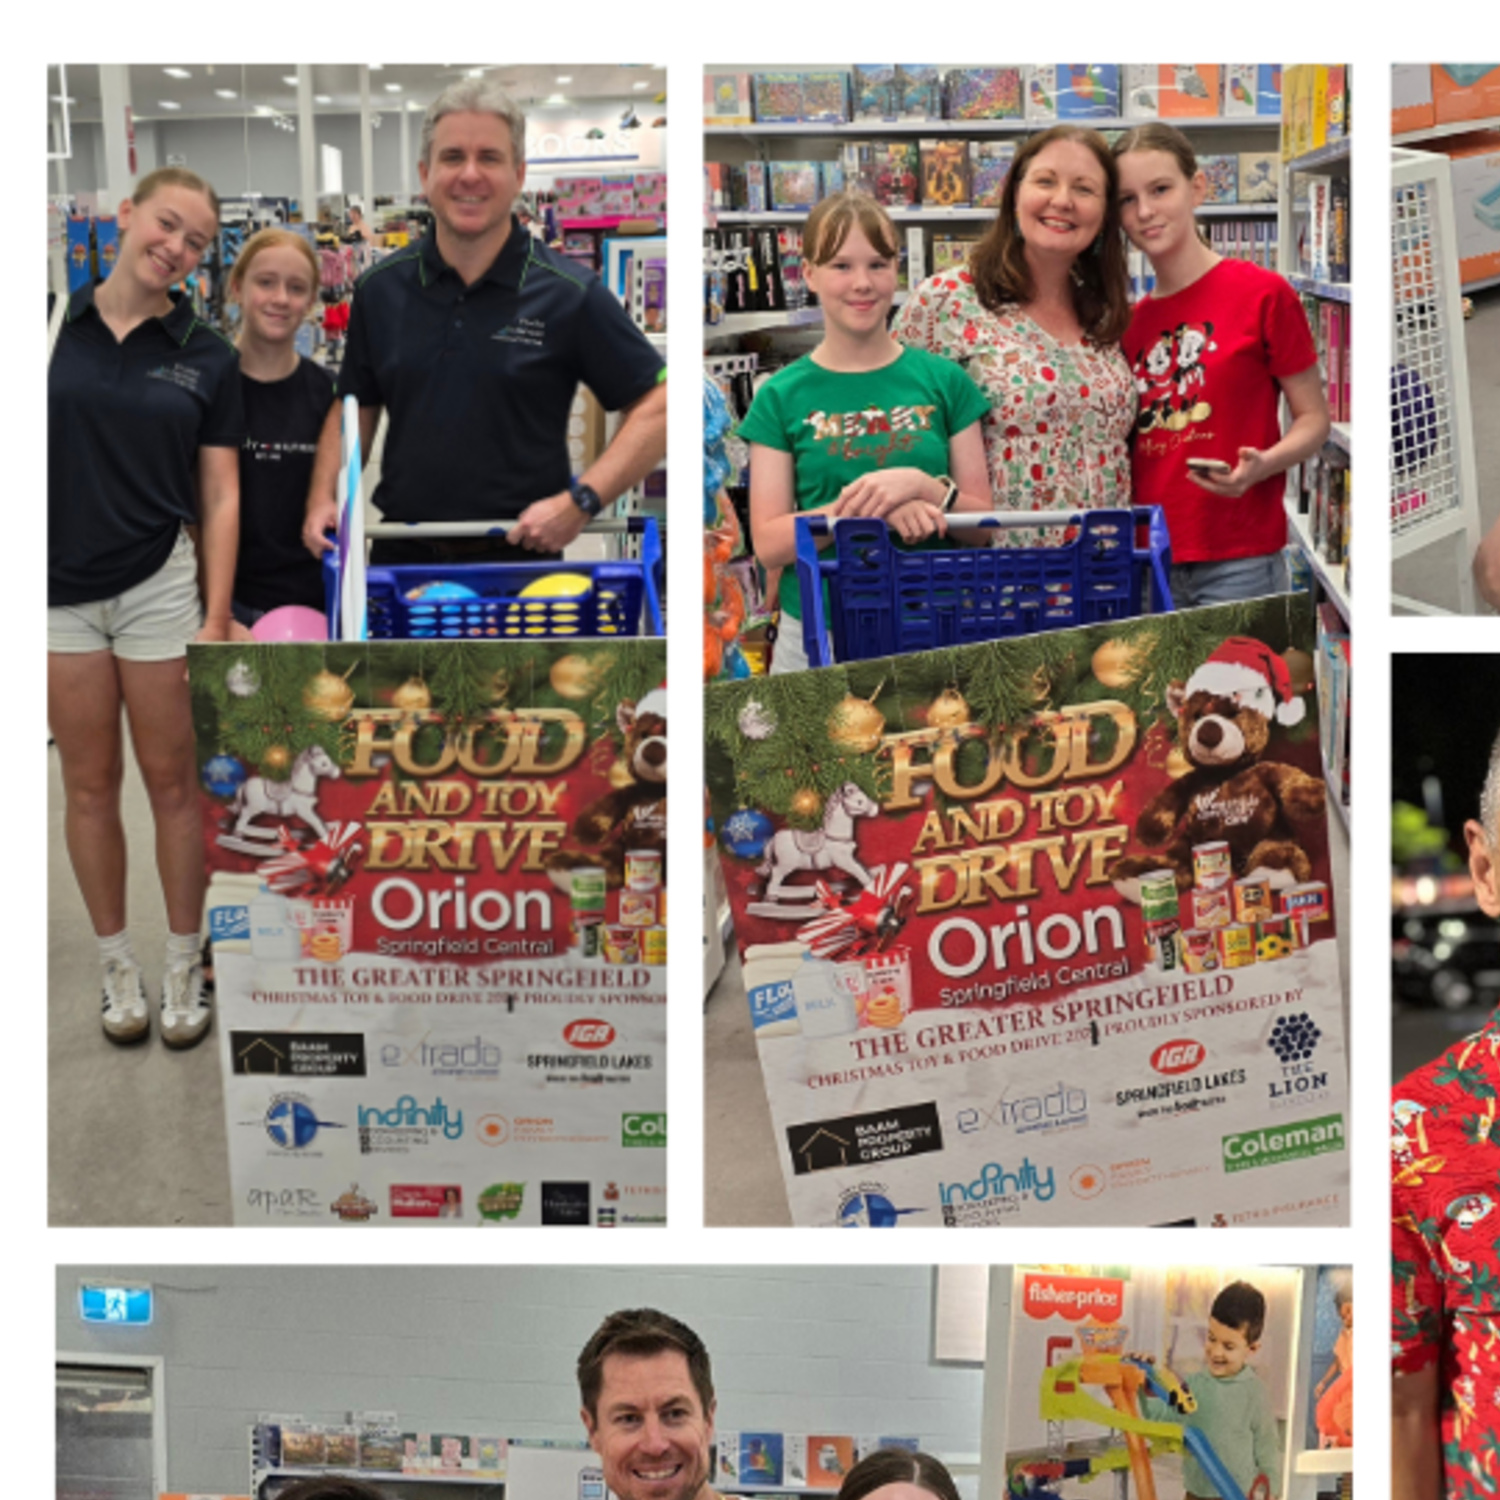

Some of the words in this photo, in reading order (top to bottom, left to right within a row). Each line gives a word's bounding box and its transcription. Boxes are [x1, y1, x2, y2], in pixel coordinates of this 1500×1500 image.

[344, 707, 586, 777] FOOD
[881, 699, 1138, 811] FOOD
[365, 780, 472, 816] AND
[477, 780, 567, 816] TOY
[911, 798, 1025, 855] AND
[1031, 780, 1125, 834] TOY
[371, 877, 553, 932] Orion
[376, 937, 480, 958] Springfield
[484, 937, 555, 956] Central
[927, 903, 1126, 979] Orion
[293, 967, 345, 987] THE
[352, 967, 470, 988] GREATER
[477, 967, 651, 988] SPRINGFIELD
[938, 970, 1052, 1008] Springfield
[1056, 957, 1130, 987] Central
[566, 1021, 614, 1046] IGA
[850, 1032, 909, 1062] THE
[916, 1004, 1046, 1049] GREATER
[1052, 974, 1235, 1027] SPRINGFIELD
[807, 1060, 904, 1090] CHRISTMAS
[909, 1053, 939, 1073] TOY
[959, 1043, 1007, 1064] FOOD
[1011, 1032, 1061, 1053] DRIVE
[1104, 1012, 1181, 1037] PROUDLY
[1183, 995, 1282, 1022] SPONSORED
[1285, 988, 1304, 1005] BY
[1157, 1043, 1200, 1070] IGA
[526, 1054, 609, 1071] SPRINGFIELD
[611, 1054, 653, 1070] LAKES
[1115, 1076, 1203, 1107] SPRINGFIELD
[1204, 1068, 1247, 1092] LAKES
[1268, 1071, 1329, 1099] LION
[1223, 1119, 1345, 1160] Coleman
[1029, 1281, 1118, 1310] fisher-price
